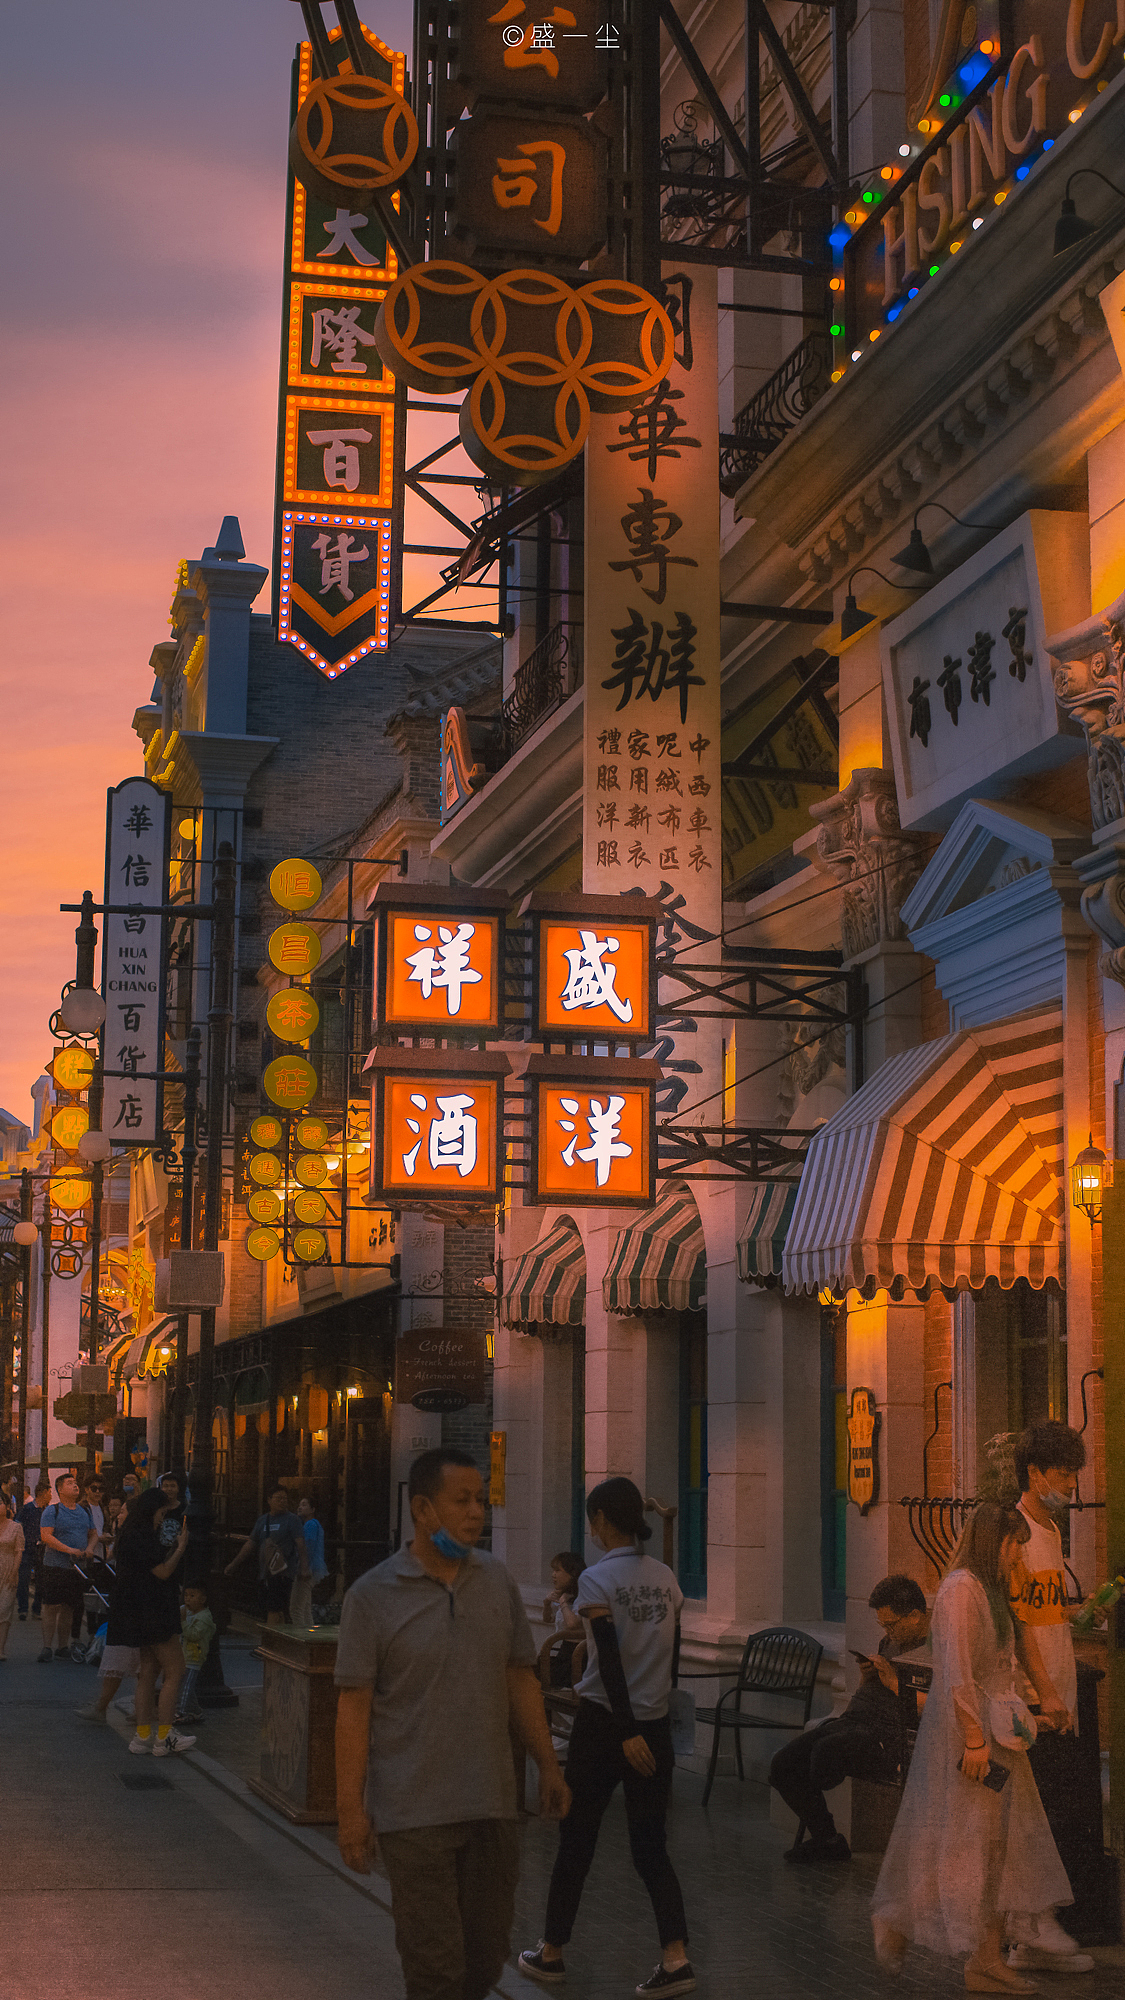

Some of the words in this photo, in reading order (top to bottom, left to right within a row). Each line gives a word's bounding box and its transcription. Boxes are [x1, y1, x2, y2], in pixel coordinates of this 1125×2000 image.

[881, 34, 1050, 306] HSING
[1066, 0, 1125, 79] C
[306, 208, 381, 601] 大隆百貨
[596, 729, 622, 868] 禮服洋服
[624, 729, 652, 869] 家用新衣
[118, 947, 148, 960] HUA
[121, 964, 146, 976] XIN
[108, 980, 158, 994] CHANG
[112, 1003, 147, 1129] 百貨店
[418, 1339, 464, 1355] Coffee
[413, 1357, 443, 1367] French
[414, 1371, 457, 1382] Afternoon
[628, 1602, 669, 1625] 电影梦
